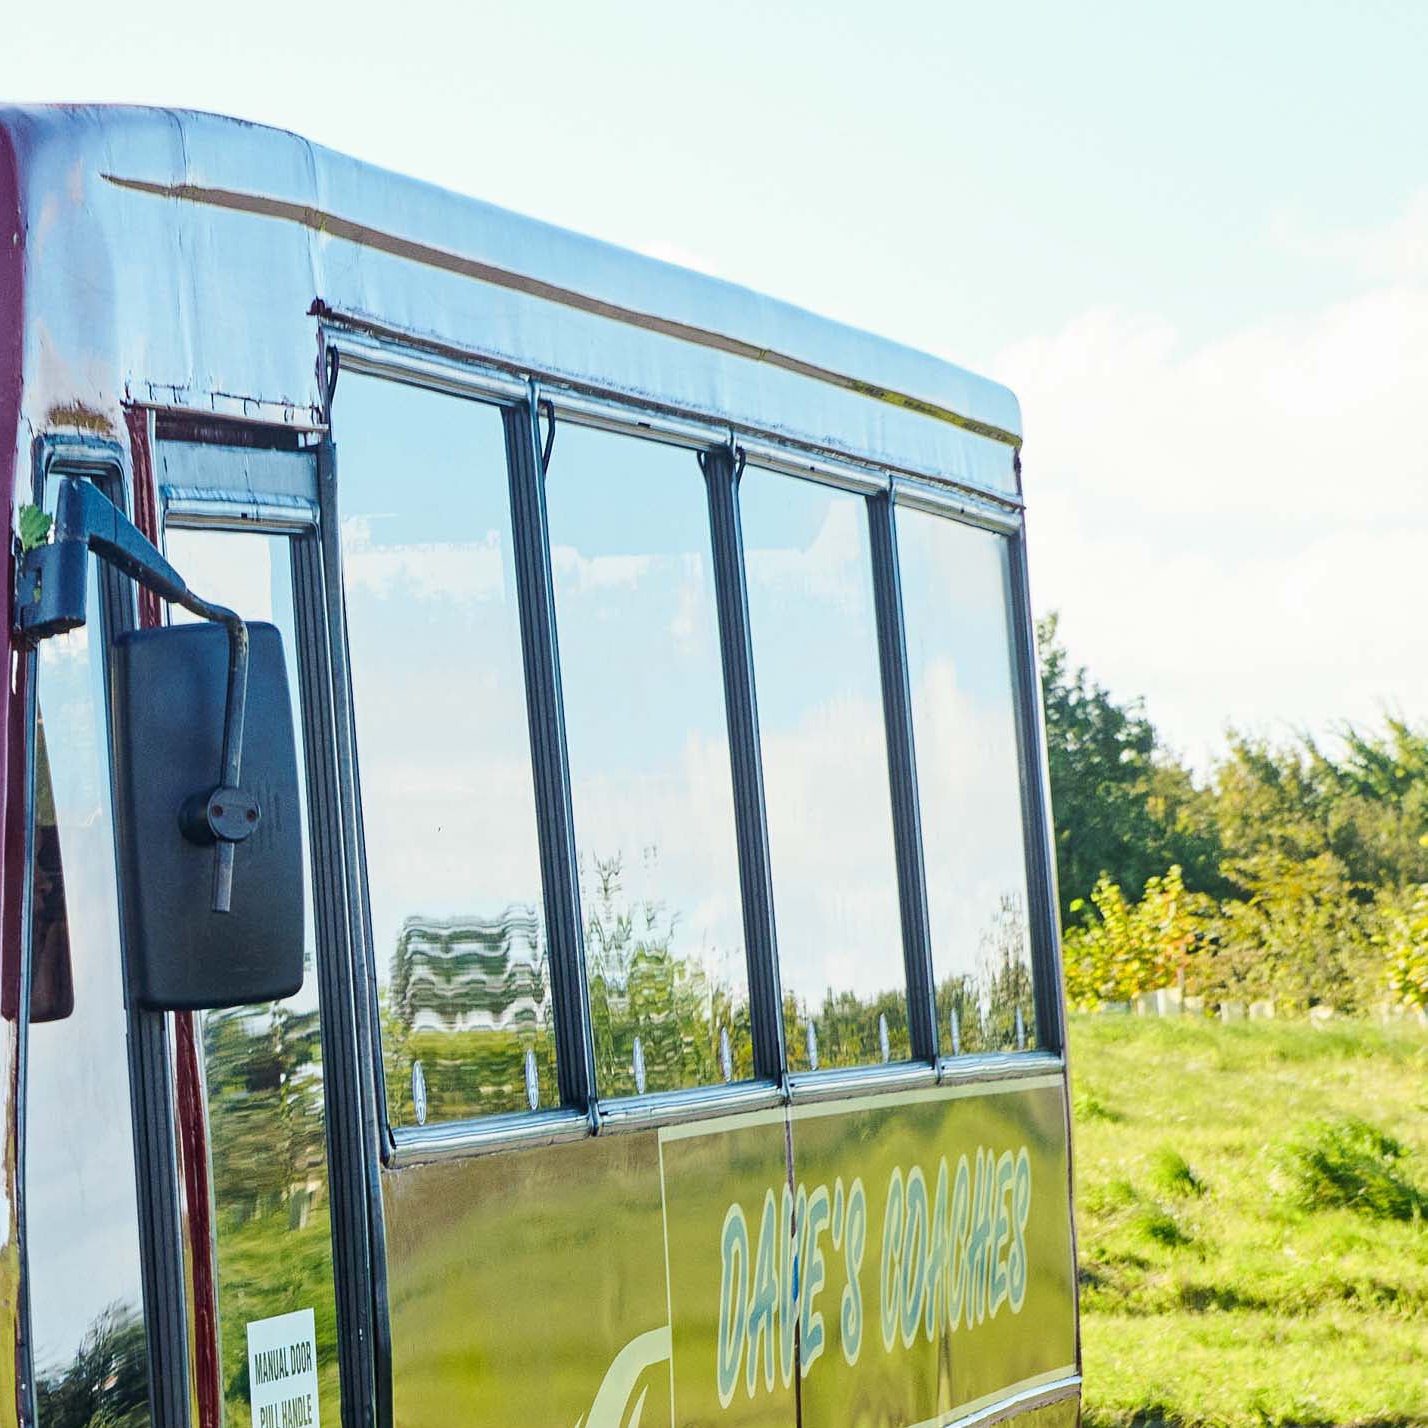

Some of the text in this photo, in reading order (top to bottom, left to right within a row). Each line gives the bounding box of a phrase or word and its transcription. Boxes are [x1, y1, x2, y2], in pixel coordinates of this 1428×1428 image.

[717, 1145, 1031, 1409] DAVE'S COACHES
[254, 1341, 312, 1385] MANUAL DOOR
